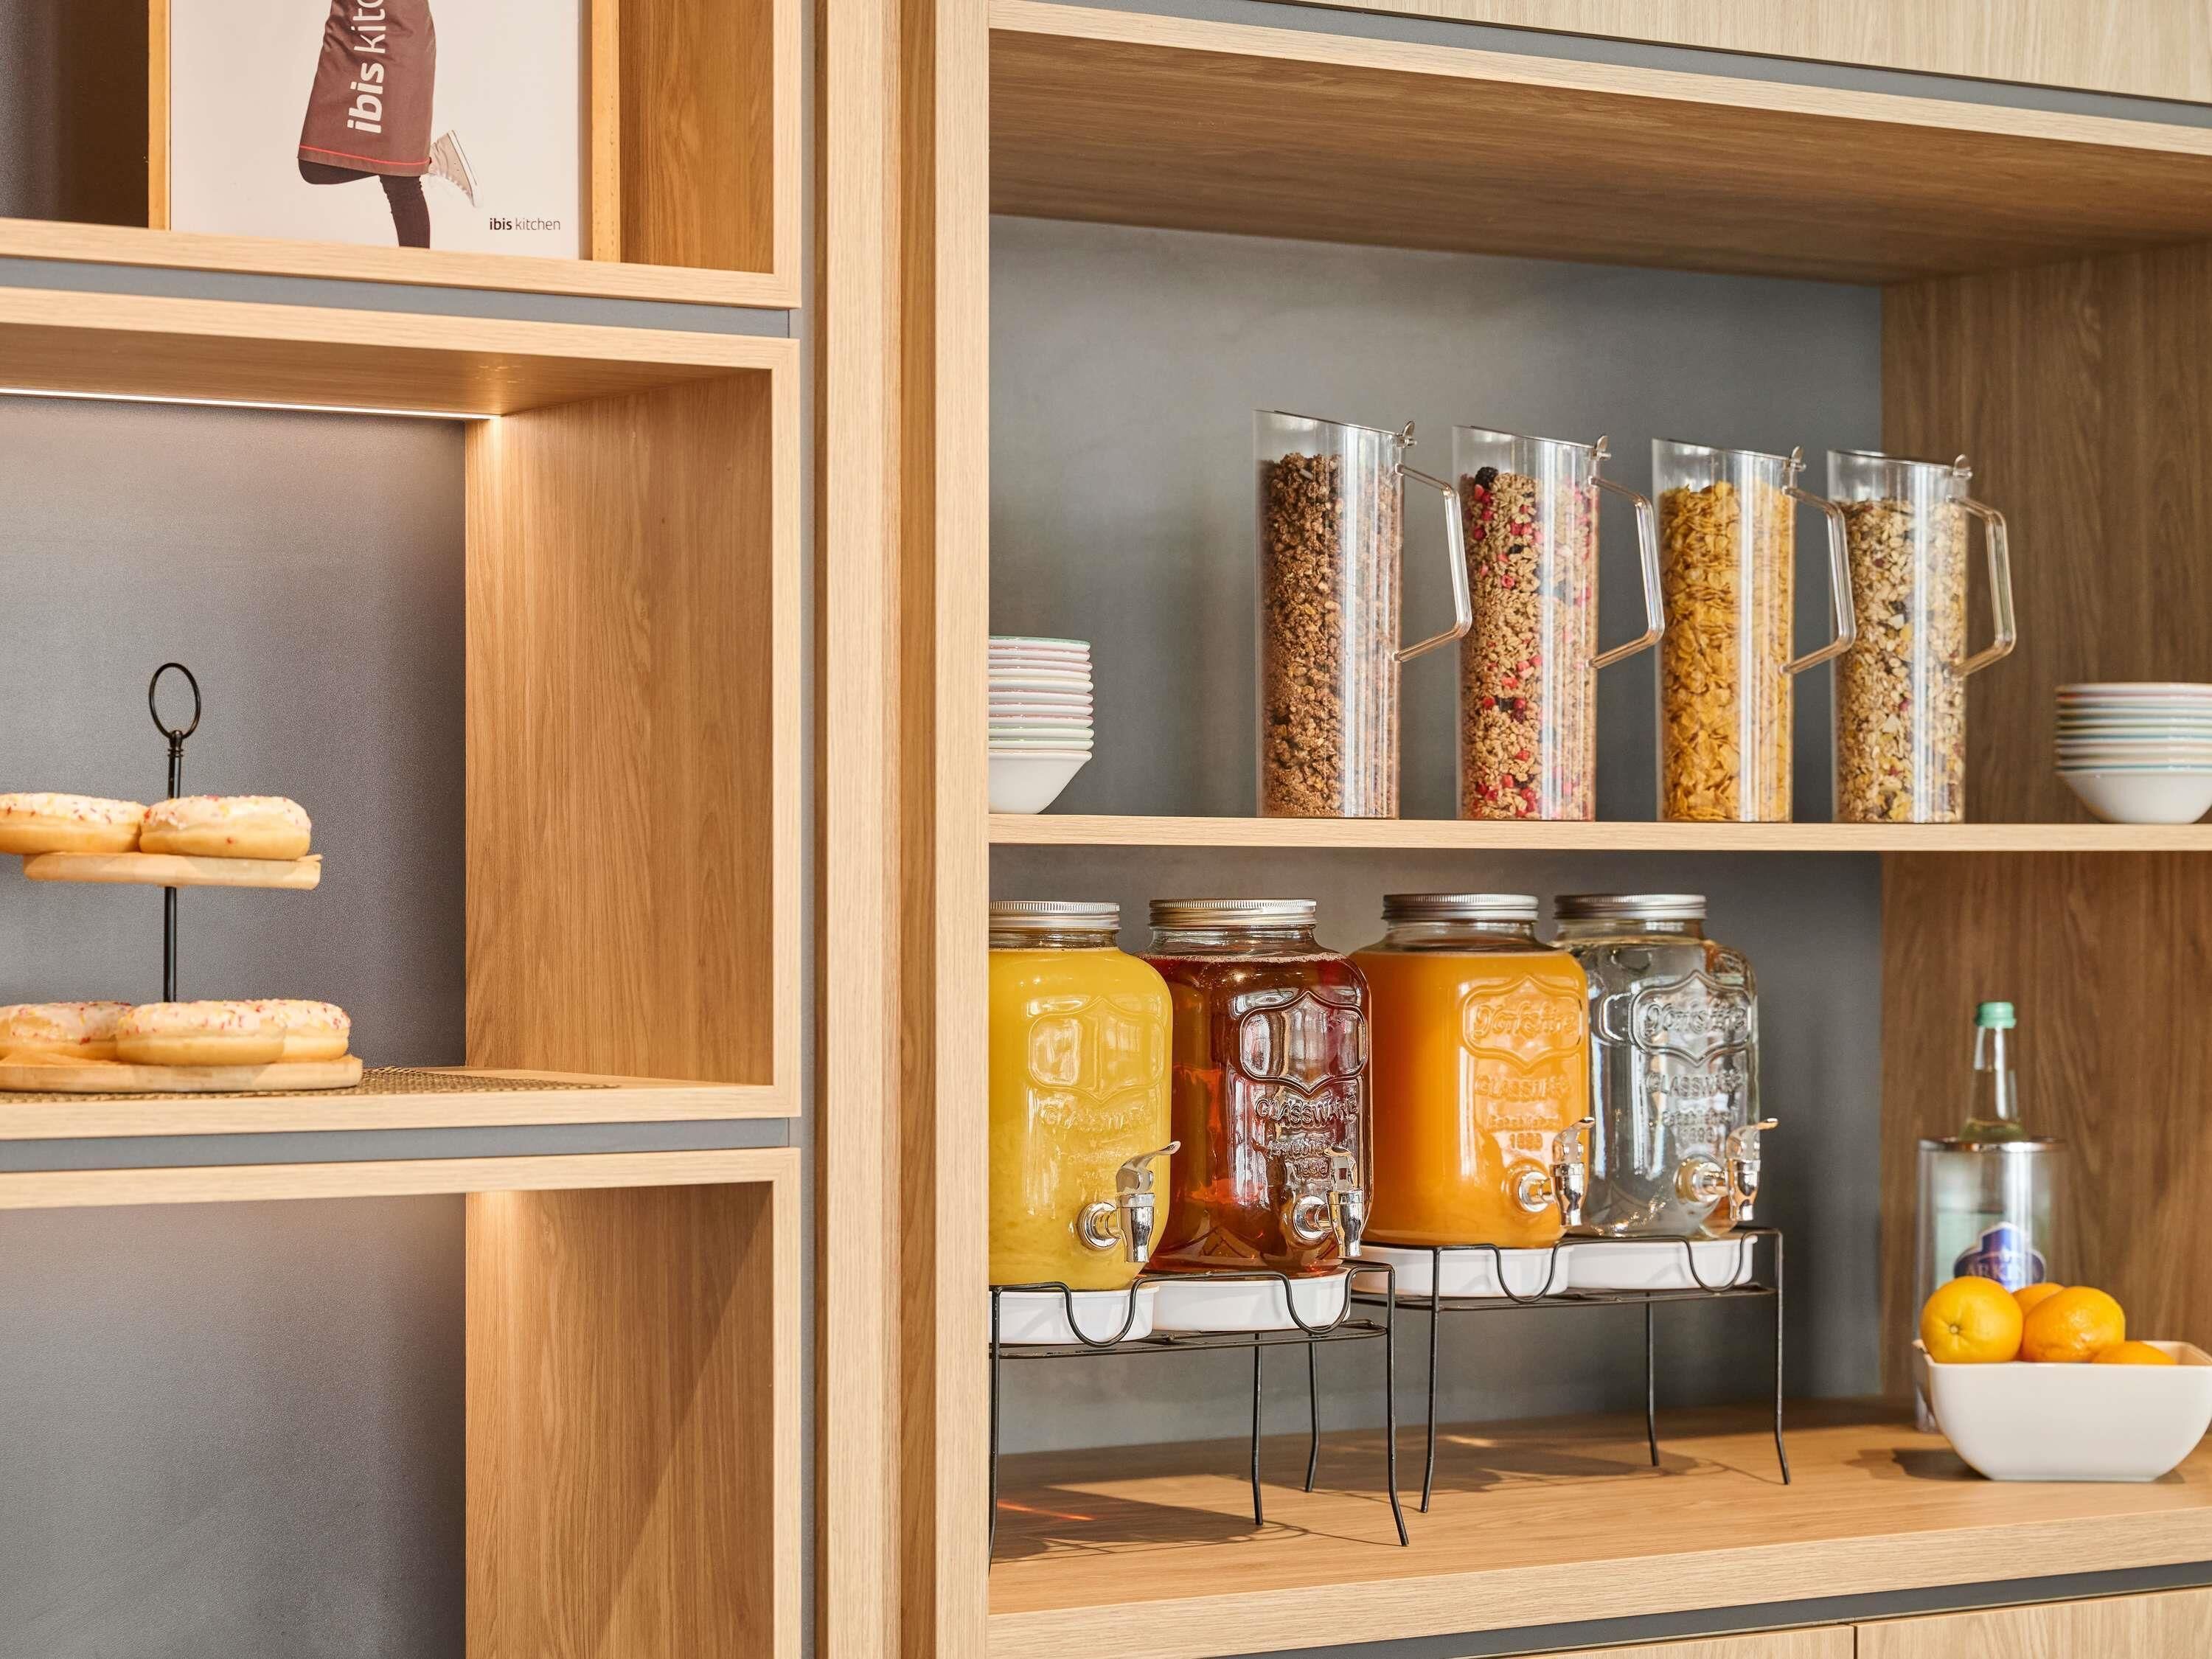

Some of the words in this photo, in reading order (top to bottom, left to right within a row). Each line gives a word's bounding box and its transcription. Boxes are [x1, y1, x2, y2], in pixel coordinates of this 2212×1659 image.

[347, 62, 385, 133] ibis
[490, 218, 512, 231] ibis
[515, 218, 560, 231] kitchen
